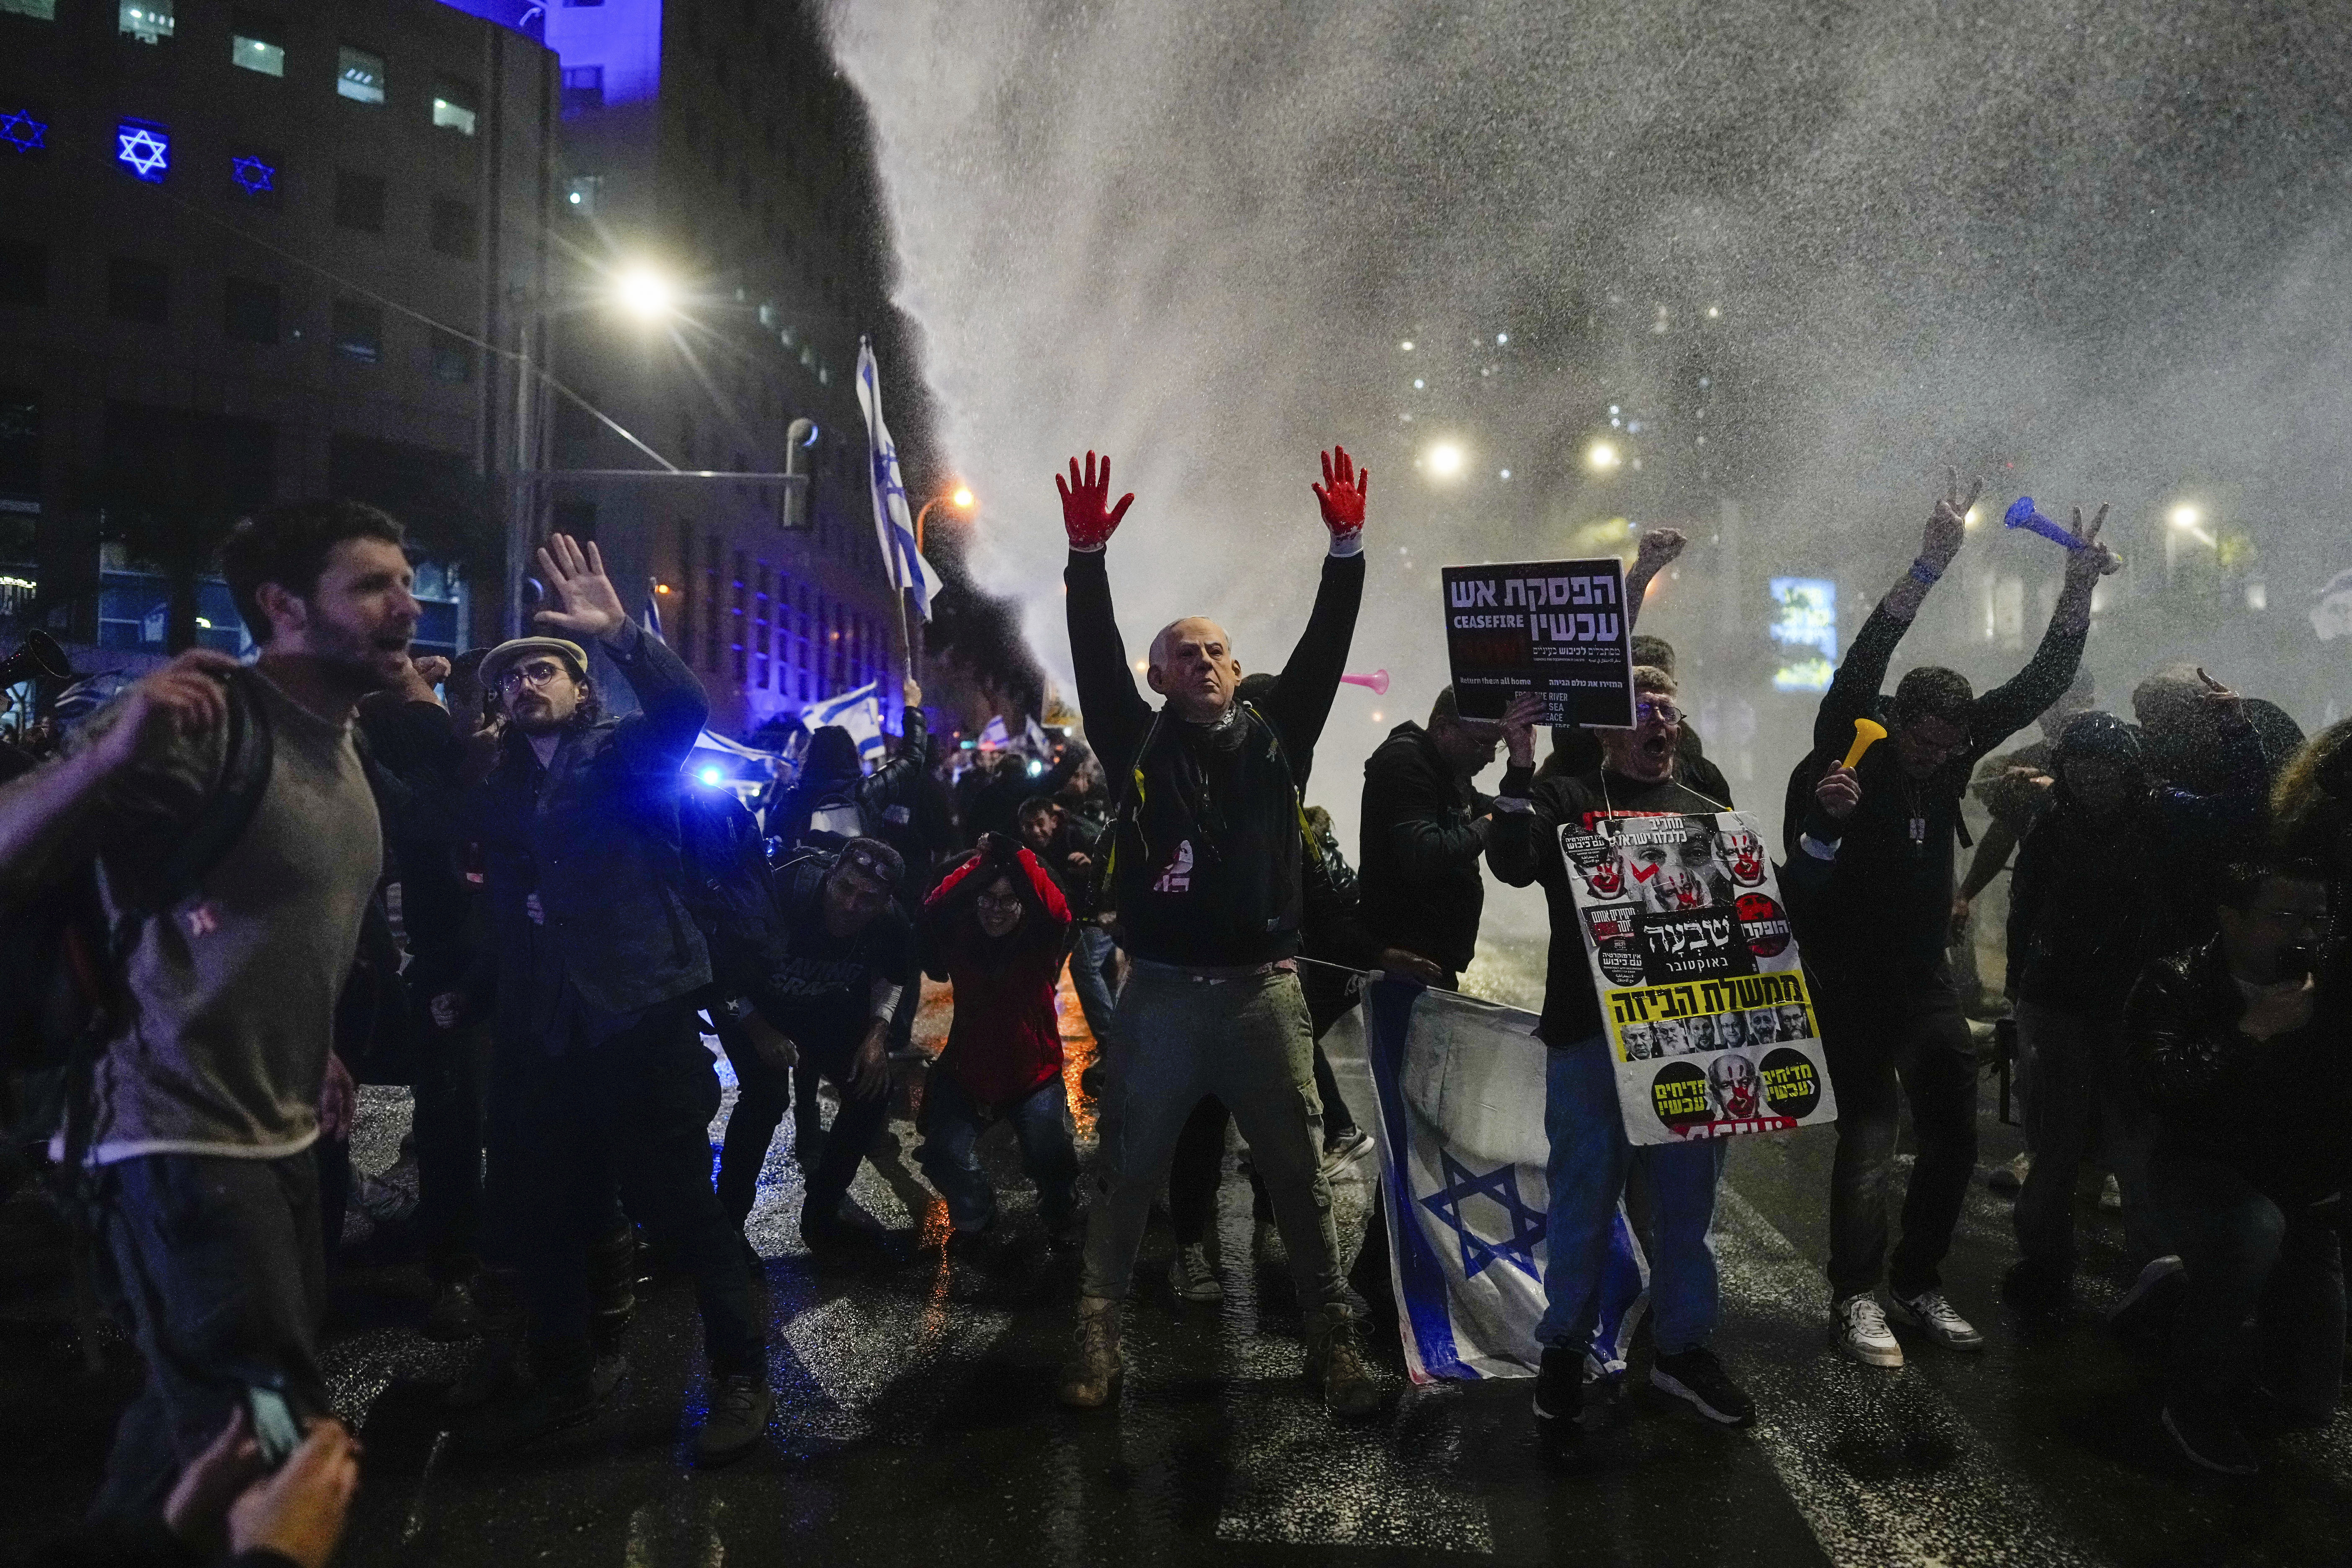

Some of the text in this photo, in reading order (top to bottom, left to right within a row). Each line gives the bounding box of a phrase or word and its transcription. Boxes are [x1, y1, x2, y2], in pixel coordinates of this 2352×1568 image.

[1451, 575, 1616, 611] הפסקת אש
[1454, 614, 1524, 629] CEASEFIRE
[1530, 613, 1619, 641] עכשיו
[1559, 646, 1586, 655] לכיבוש
[1588, 645, 1620, 656] מסתכלים
[1511, 677, 1532, 685] home
[1549, 692, 1568, 701] RIVER
[1549, 703, 1564, 712] SEA
[1545, 712, 1563, 722] EACE
[1649, 817, 1684, 830] מחריב
[1653, 829, 1687, 844] כלכלת
[1567, 841, 1591, 849] כיבוש
[1591, 910, 1611, 923] אותם
[1666, 957, 1728, 973] באוקטובר
[1611, 974, 1803, 1023] ממשלת הביזה
[1761, 1064, 1813, 1085] מדיחים
